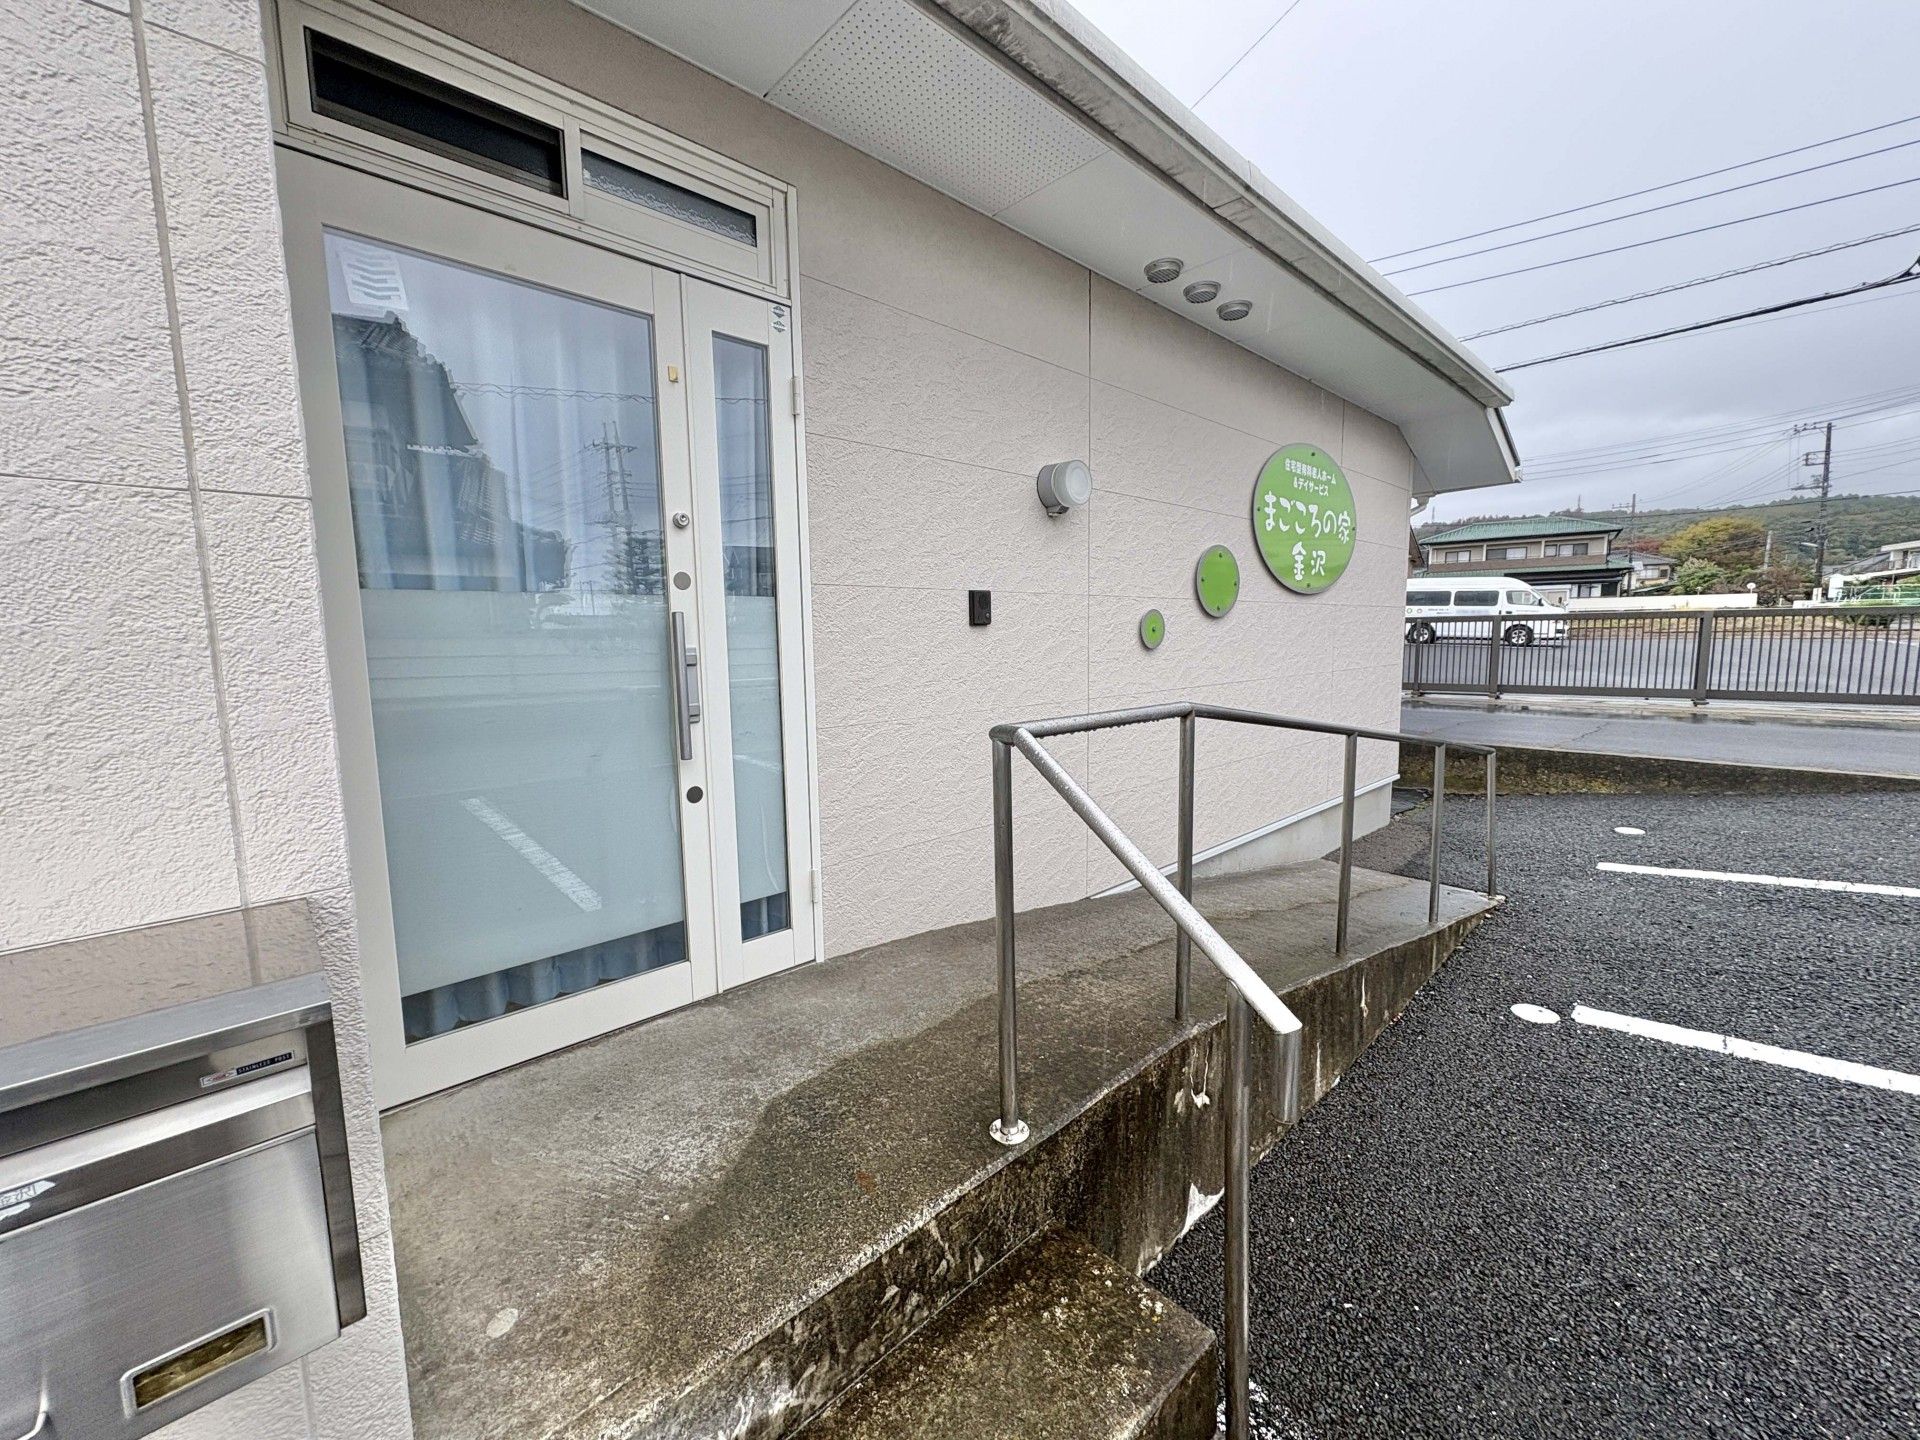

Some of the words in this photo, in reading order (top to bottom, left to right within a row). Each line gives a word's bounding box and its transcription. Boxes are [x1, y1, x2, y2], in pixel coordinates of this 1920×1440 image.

[1264, 490, 1351, 544] まごころの家
[1292, 541, 1326, 581] 金沢
[274, 1053, 290, 1063] POST
